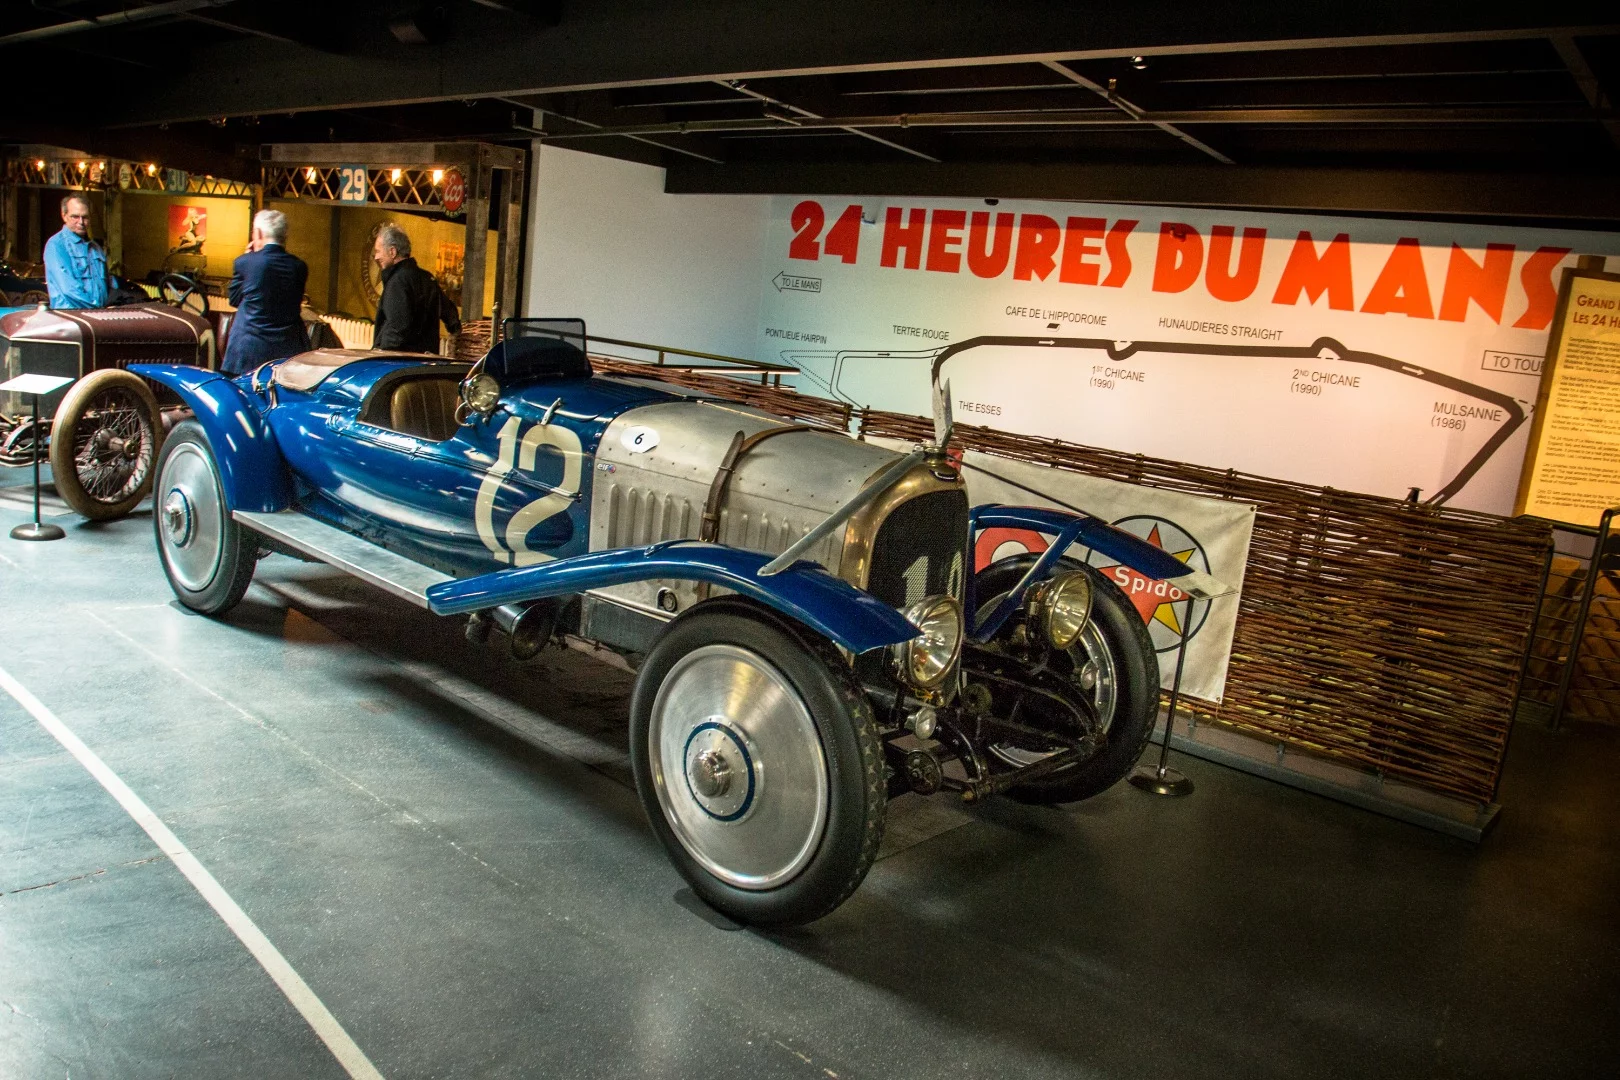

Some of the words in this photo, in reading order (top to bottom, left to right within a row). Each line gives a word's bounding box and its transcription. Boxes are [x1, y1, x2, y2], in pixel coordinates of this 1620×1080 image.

[341, 168, 366, 201] 29
[788, 200, 863, 264] 24
[880, 207, 1140, 288] HEURES
[1152, 222, 1267, 303] DU
[1272, 231, 1573, 331] MANS
[782, 278, 791, 287] TO
[792, 279, 800, 288] LE
[800, 280, 820, 290] MANS
[1577, 295, 1615, 310] GRAND
[1005, 305, 1027, 318] CAFE
[1029, 308, 1041, 318] DE
[1043, 310, 1107, 326] L'HIPPODROME
[1573, 312, 1589, 324] LES
[1592, 314, 1606, 326] 24
[765, 328, 800, 340] PONTLIEUE
[800, 332, 827, 345] HAIRPIN
[892, 325, 920, 337] TERTRE
[922, 329, 950, 341] ROUGE
[1158, 318, 1229, 335] HUNAUDIERES
[1231, 325, 1283, 341] STRAIGHT
[1493, 355, 1509, 369] TO
[1104, 367, 1145, 382] CHICANE
[1311, 371, 1361, 388] CHICANE
[1089, 377, 1116, 390] (1990)
[1290, 382, 1322, 397] (1990)
[958, 401, 975, 411] THE
[976, 403, 1002, 416] ESSES
[1433, 402, 1502, 422] MULSANNE
[1431, 418, 1467, 432] (1986)
[634, 433, 645, 445] 6
[597, 463, 609, 471] elf
[475, 416, 583, 567] 12
[1114, 566, 1182, 601] Spido
